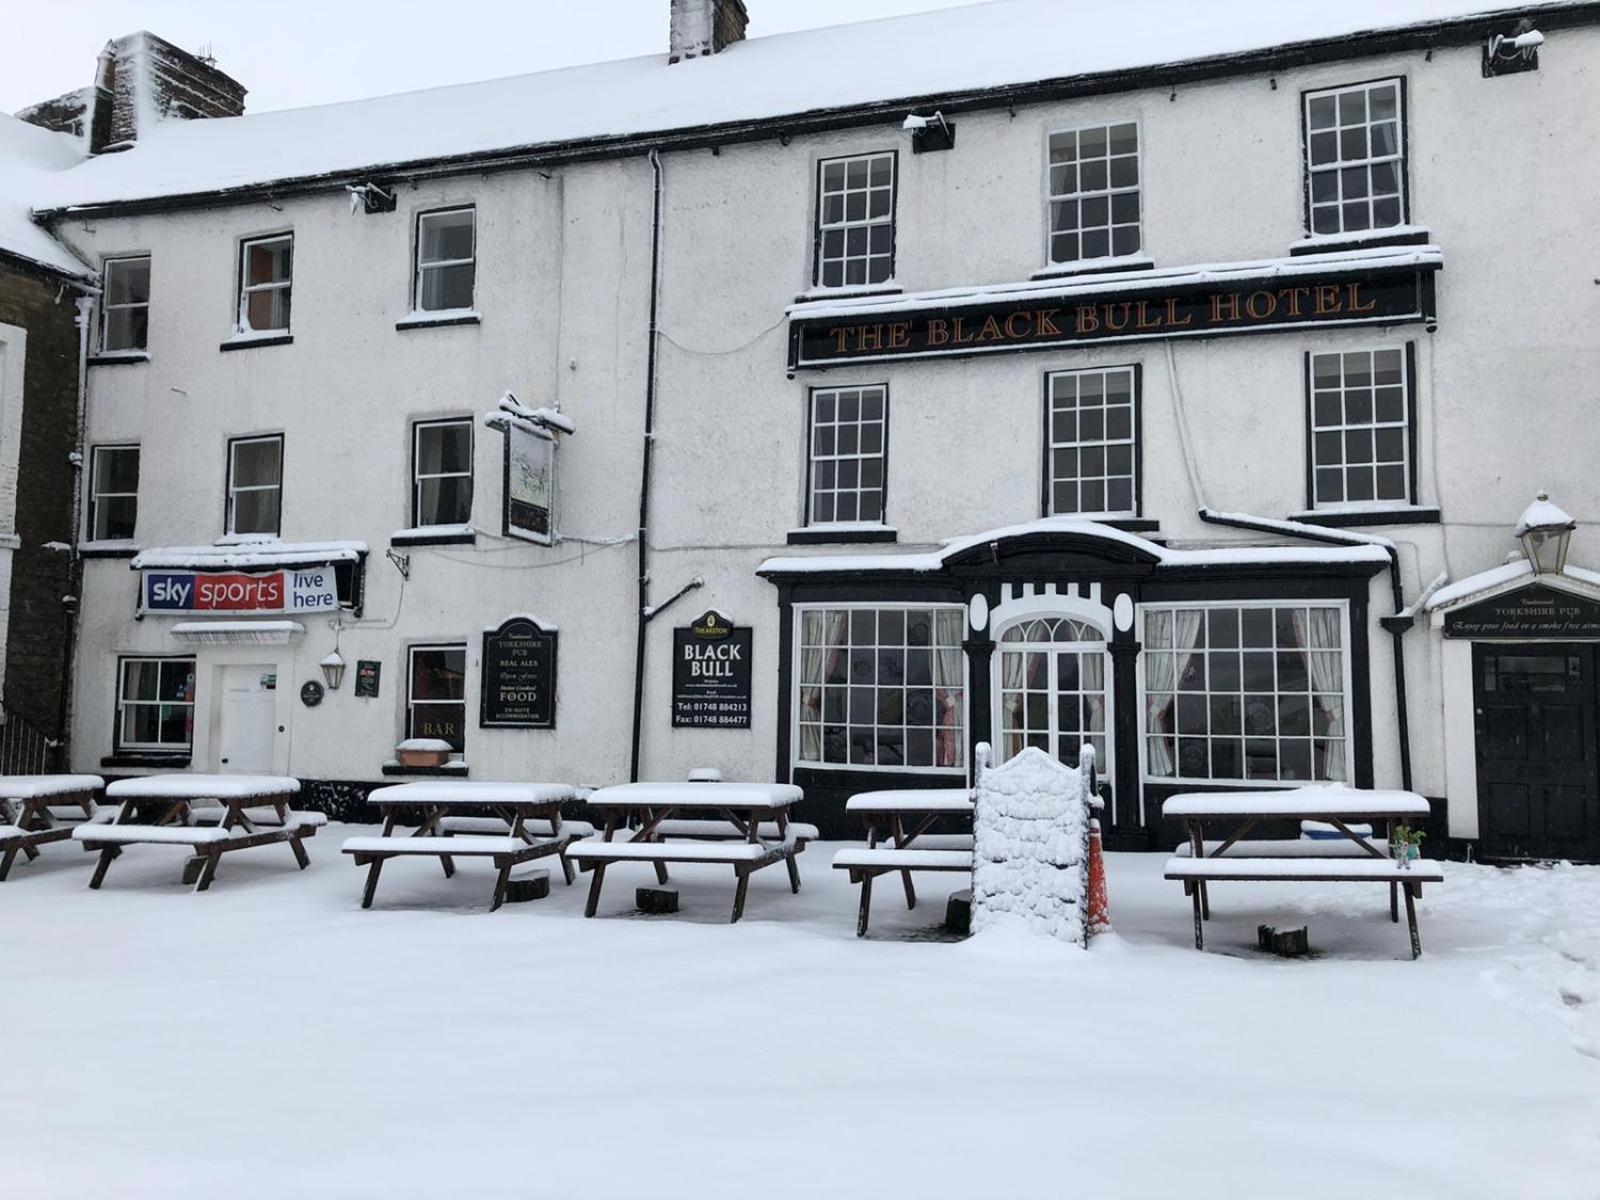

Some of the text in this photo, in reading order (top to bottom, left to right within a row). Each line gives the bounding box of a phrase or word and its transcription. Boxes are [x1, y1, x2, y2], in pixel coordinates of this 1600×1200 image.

[829, 283, 1378, 354] THE BLACK BULL HOTEL
[293, 573, 324, 588] live
[152, 577, 278, 608] sky sports
[293, 591, 334, 608] here
[1494, 607, 1581, 616] YORKSHIRE PUB
[1502, 621, 1520, 632] food
[684, 644, 742, 660] BLACK
[691, 660, 733, 677] BULL
[500, 692, 537, 702] FOOD
[677, 702, 748, 712] Tel: 01748 884213
[675, 715, 692, 723] Fax:
[693, 715, 718, 724] 01748
[423, 722, 455, 736] BAR
